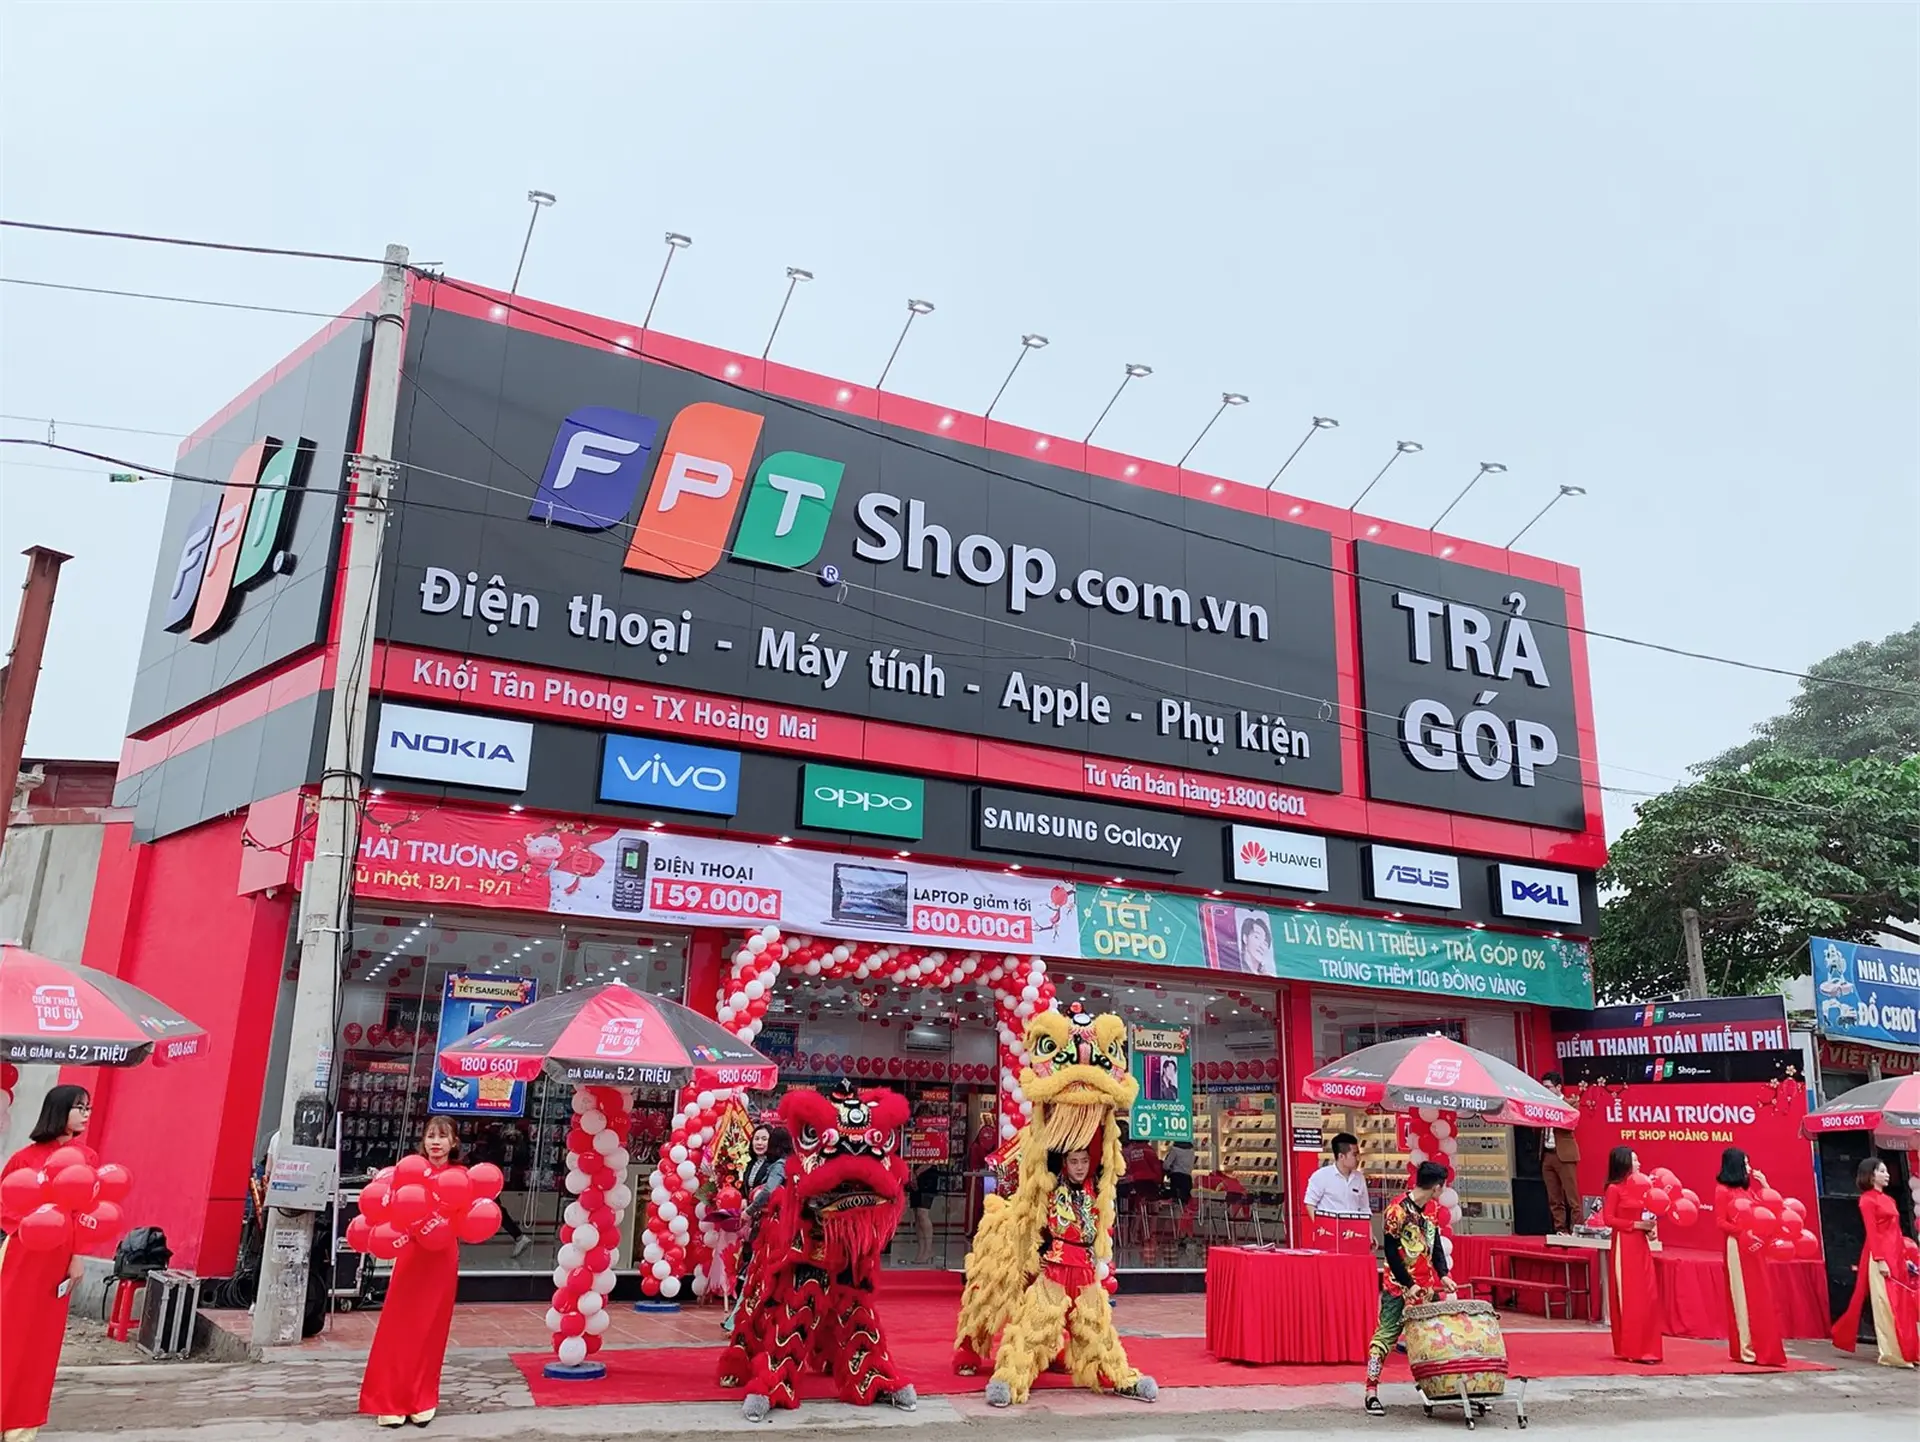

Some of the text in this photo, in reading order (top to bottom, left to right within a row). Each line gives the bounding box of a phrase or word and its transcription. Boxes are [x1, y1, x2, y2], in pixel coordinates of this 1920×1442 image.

[548, 424, 830, 545] FPT
[854, 491, 1270, 642] Shop.com.vn
[1394, 590, 1552, 688] TRẢ
[420, 565, 540, 636] Điện
[567, 594, 692, 664] thoại
[756, 626, 849, 690] Máy
[869, 647, 947, 698] tính
[1000, 671, 1112, 727] Apple
[1160, 697, 1226, 756] Phụ
[1239, 710, 1312, 765] kiện
[412, 656, 479, 692] Khối
[490, 668, 537, 701] Tân
[543, 676, 629, 720] Phong
[652, 694, 685, 724] TX
[693, 700, 770, 742] Hoàng
[778, 713, 819, 743] Mai
[390, 730, 515, 765] NOKIA
[1401, 690, 1560, 788] GÓP
[617, 752, 728, 793] vivo
[813, 786, 913, 813] oppo
[1085, 763, 1109, 788] Tư
[1111, 763, 1143, 793] vấn
[1144, 770, 1176, 798] bán
[1268, 791, 1309, 818] 6601
[983, 806, 1183, 858] SAMSUNG Galaxy
[407, 839, 520, 872] TRƯƠNG
[654, 855, 754, 884] ĐIỆN THOẠI
[1269, 849, 1322, 870] HUAWEI
[373, 869, 424, 893] nhật,
[428, 873, 462, 892] 13/1
[478, 877, 512, 896] 19/1
[1385, 864, 1450, 890] ASUS
[653, 881, 778, 916] 159.000đ
[912, 887, 1032, 912] LAPTOP giảm tới
[1510, 879, 1570, 907] DELL
[916, 908, 1026, 940] 800.000đ
[1101, 891, 1151, 930] TẾT
[1094, 930, 1167, 959] OPPO
[1284, 914, 1301, 944] LÌ
[1304, 918, 1322, 946] XÌ
[1326, 921, 1364, 951] ĐẾN
[1378, 930, 1426, 962] TRIỆU
[1442, 938, 1477, 963] TRẢ
[1480, 942, 1518, 968] GÓP
[1522, 949, 1546, 970] 0%
[1319, 957, 1527, 996] TRÚNG THÊM 100 ĐỒNG VÀNG
[1857, 958, 1888, 982] NHÀ
[457, 984, 519, 997] TẾT SAMSUNG
[1857, 991, 1918, 1033] ĐỒ CHƠI
[68, 1044, 89, 1060] 5.2
[93, 1044, 128, 1064] TRIỆU
[1152, 1041, 1173, 1050] OPPO
[1556, 1025, 1783, 1059] ĐIỂM THANH TOÁN MIỄN PHÍ
[460, 1057, 519, 1074] 1800 6601
[617, 1066, 636, 1081] 5.2
[639, 1066, 672, 1086] TRIỆU
[716, 1068, 762, 1084] 1800 6601
[1322, 1082, 1367, 1098] 1800 6601
[1442, 1095, 1458, 1107] 5.2
[1460, 1096, 1487, 1112] TRIỆU
[1163, 1116, 1188, 1130] 100
[1523, 1104, 1564, 1123] 1800 6601
[1606, 1099, 1756, 1124] LỄ KHAI TRƯƠNG
[1821, 1114, 1865, 1128] 1800 6601
[1620, 1127, 1733, 1143] FPT SHOP HOÀNG MAI
